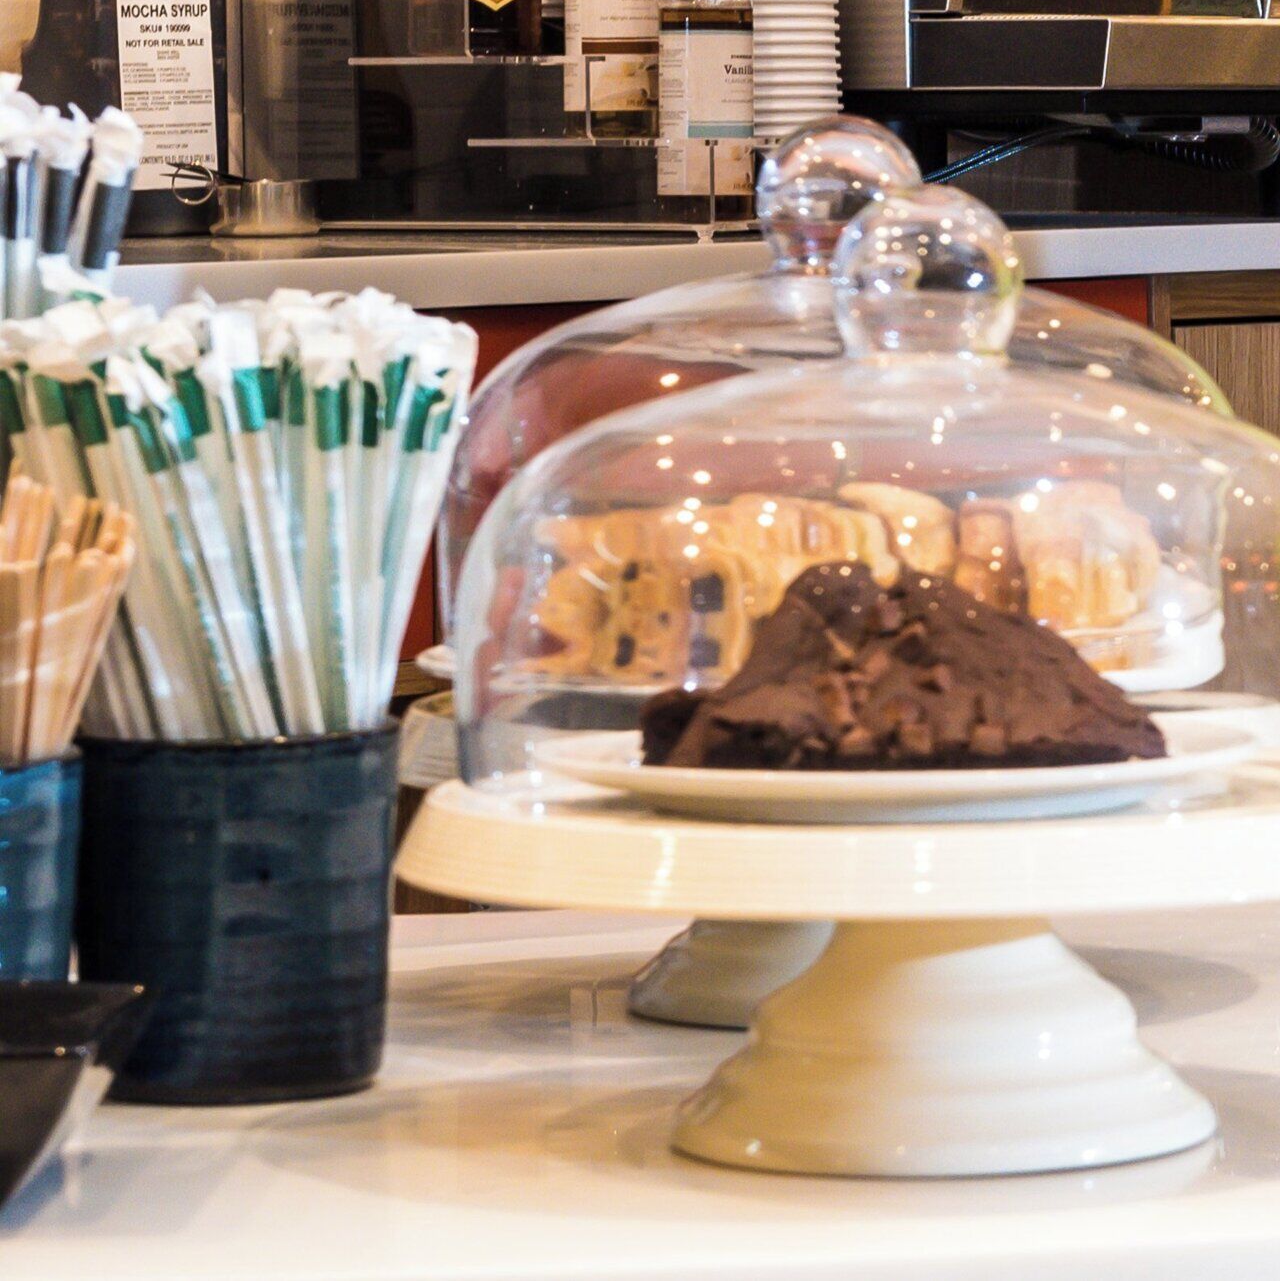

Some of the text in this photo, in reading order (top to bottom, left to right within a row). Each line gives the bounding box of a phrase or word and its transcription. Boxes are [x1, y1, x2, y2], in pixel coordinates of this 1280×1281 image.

[121, 4, 207, 18] MOCHA SYRUP
[139, 24, 162, 33] SKU#
[125, 38, 204, 48] NOT FOR RETAIL SALE
